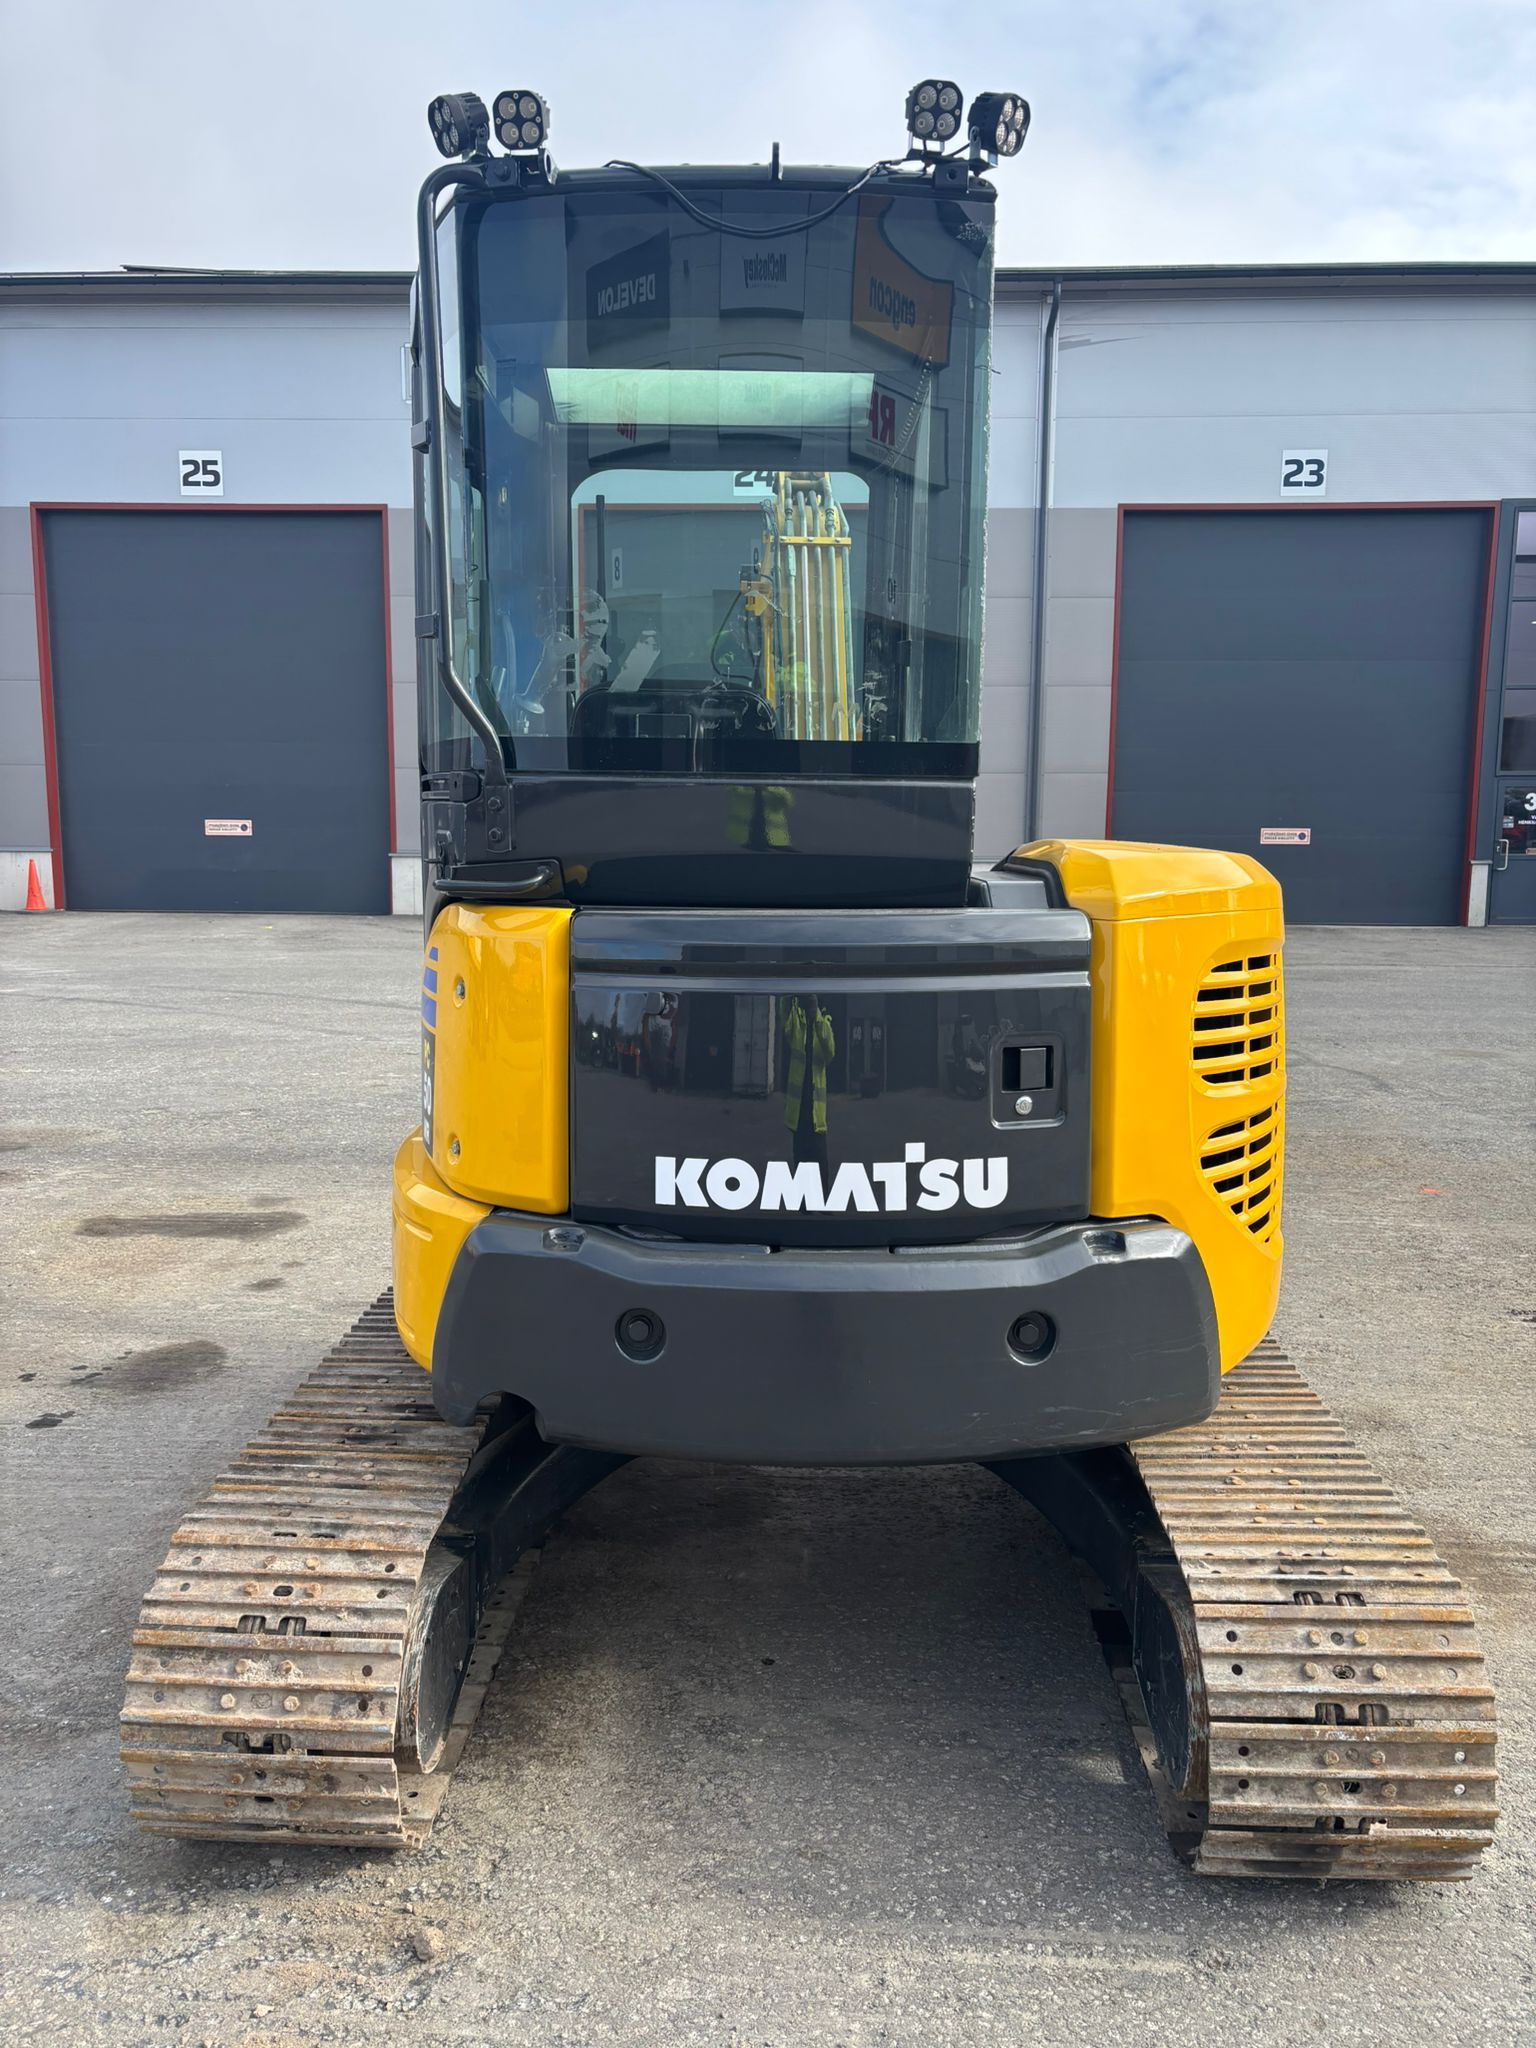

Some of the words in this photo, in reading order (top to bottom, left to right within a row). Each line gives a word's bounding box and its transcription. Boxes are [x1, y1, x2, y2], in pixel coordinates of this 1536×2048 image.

[181, 459, 221, 487] 25
[734, 471, 774, 487] 24
[1282, 458, 1325, 487] 23
[654, 1142, 1009, 1212] KOMATSU
